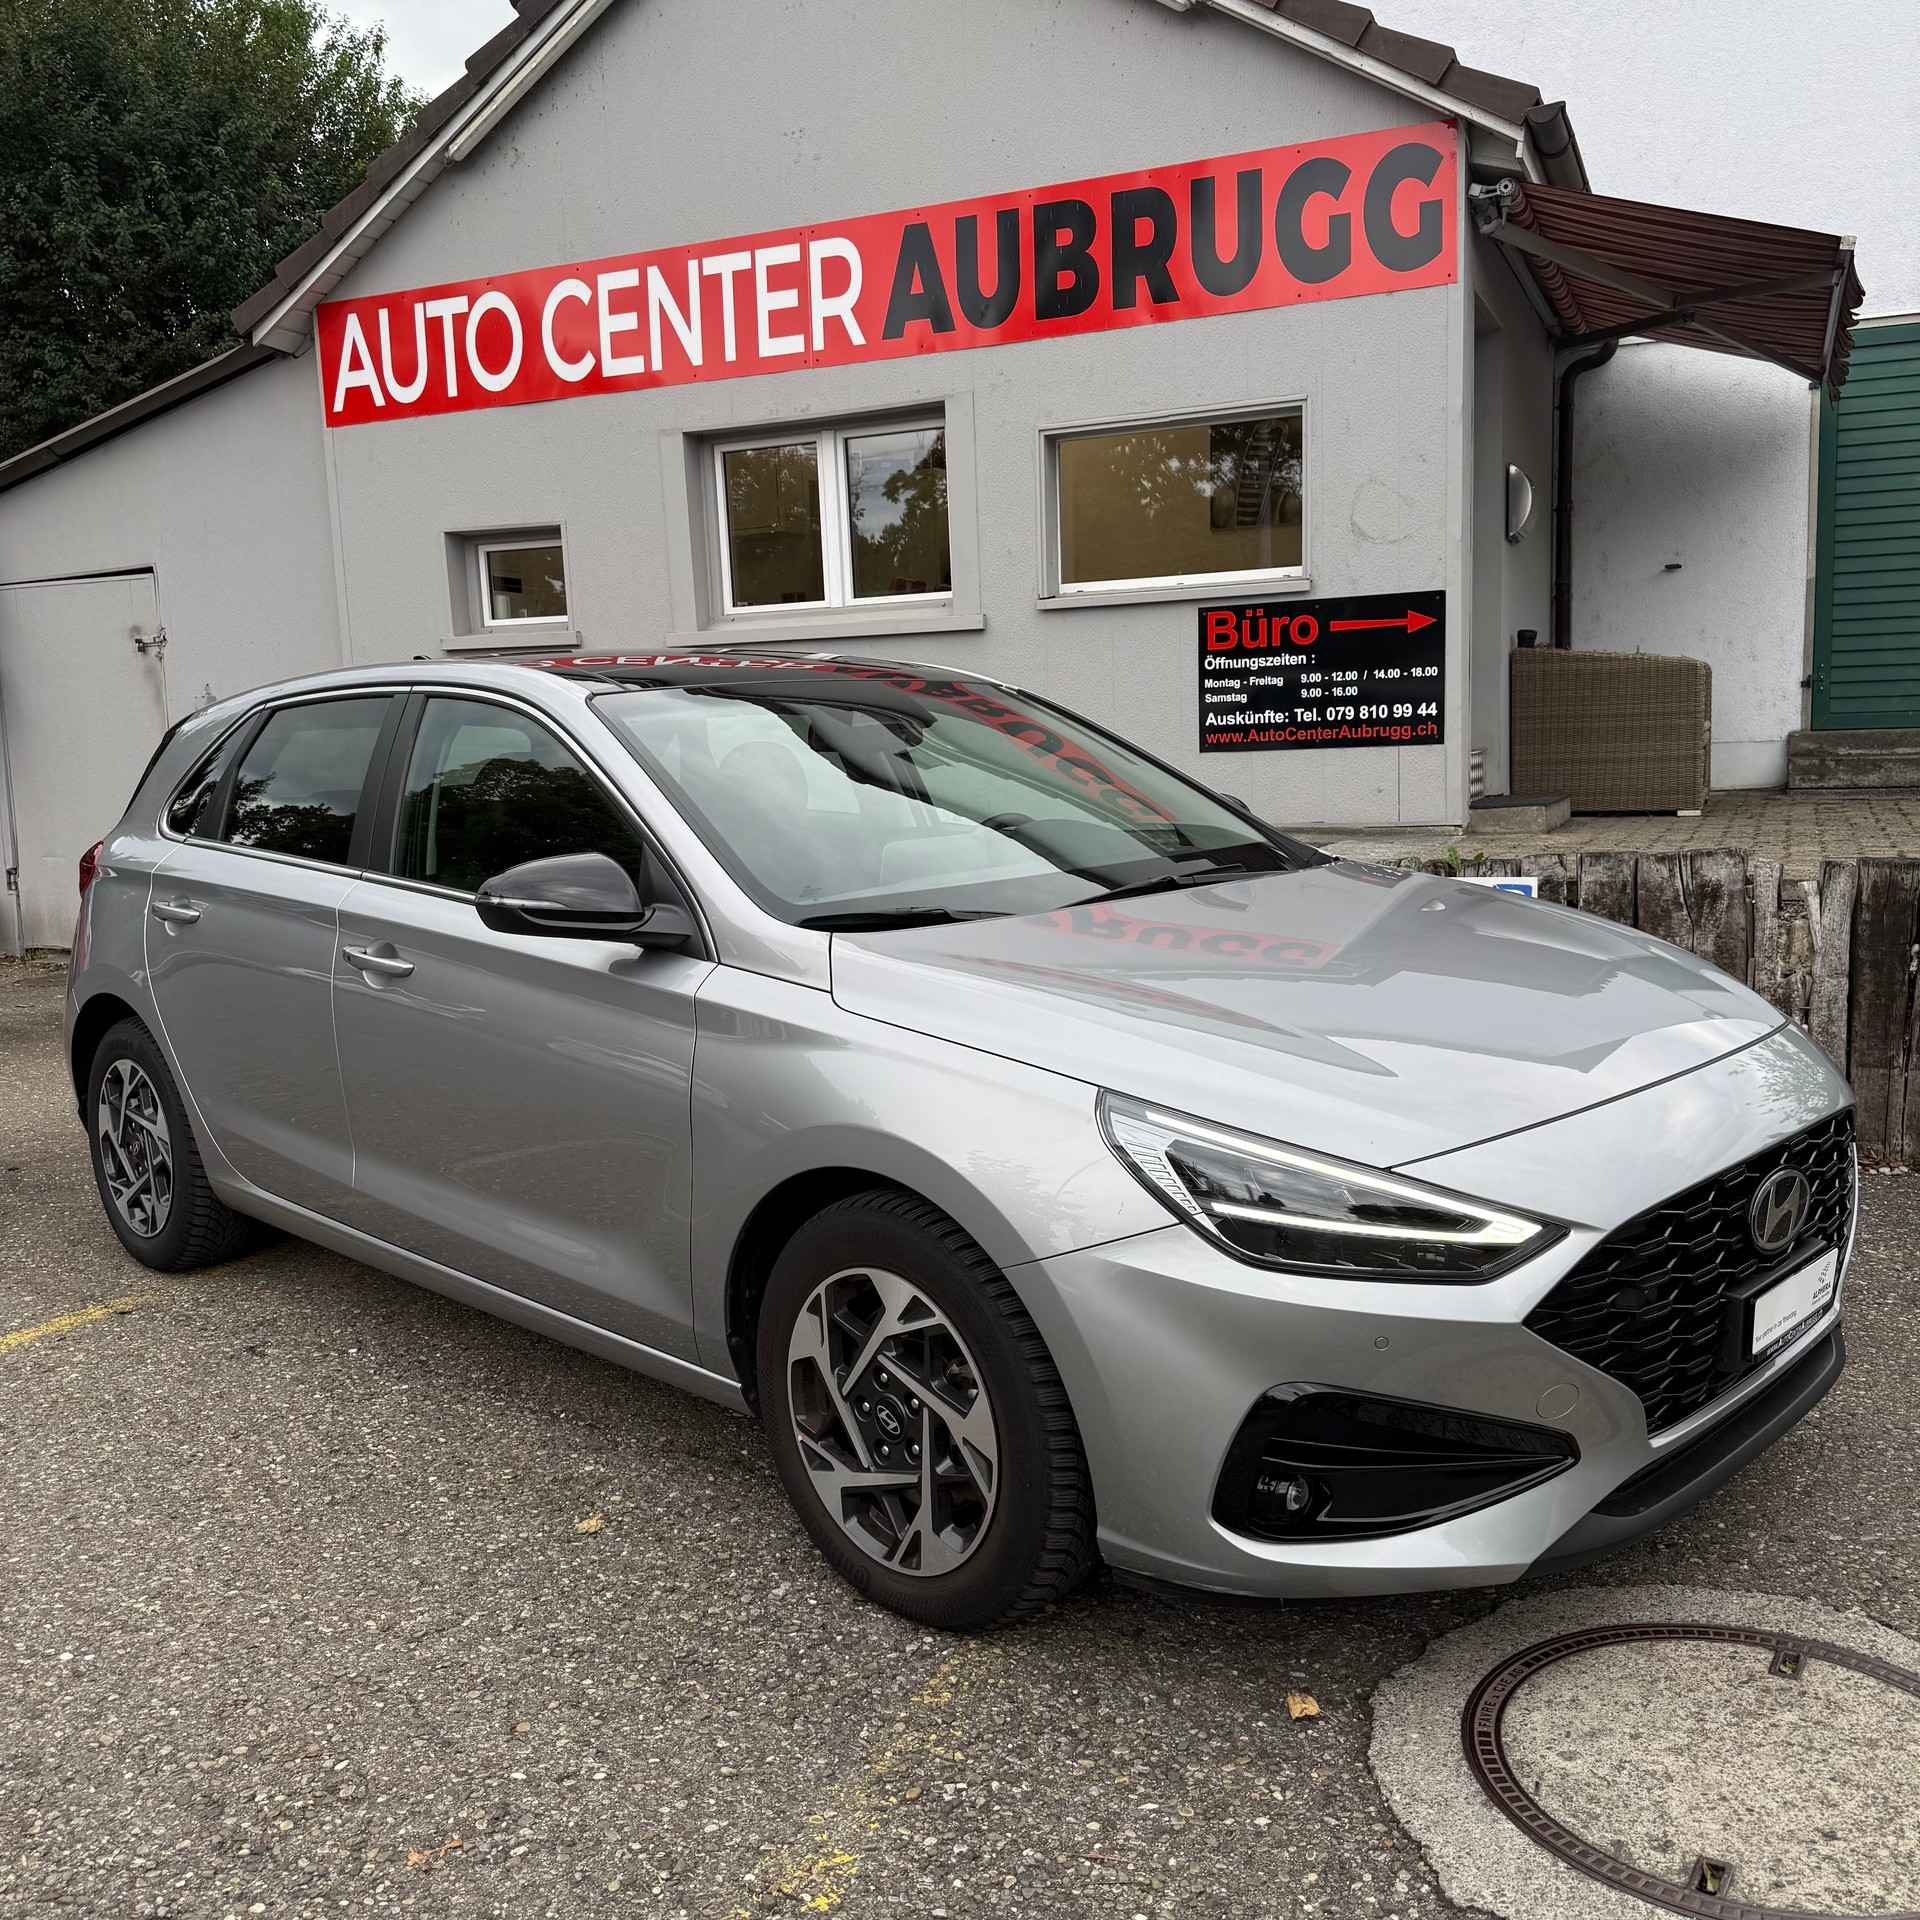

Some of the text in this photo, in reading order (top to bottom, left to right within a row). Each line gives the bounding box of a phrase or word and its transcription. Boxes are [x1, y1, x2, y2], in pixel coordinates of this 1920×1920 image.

[333, 142, 1444, 412] AUTO CENTER AUBRUGG
[1207, 608, 1319, 650] Büro
[1204, 653, 1306, 670] Öffnungszeiten
[1204, 678, 1240, 689] Montag
[1250, 676, 1283, 687] Freitag
[1301, 673, 1321, 683] 9.00
[1332, 671, 1358, 681] 12.00
[1363, 670, 1367, 680] /
[1373, 669, 1400, 679] 14.00
[1411, 666, 1438, 677] 18.00
[1205, 693, 1247, 703] Samstag
[1301, 688, 1321, 698] 9.00
[1332, 686, 1358, 696] 16.00
[1205, 702, 1437, 726] Auskünfte: Tel. 079 810 99 44
[1206, 722, 1437, 744] www.AutoCenterAubrugg.ch
[1494, 1678, 1512, 1692] CIE
